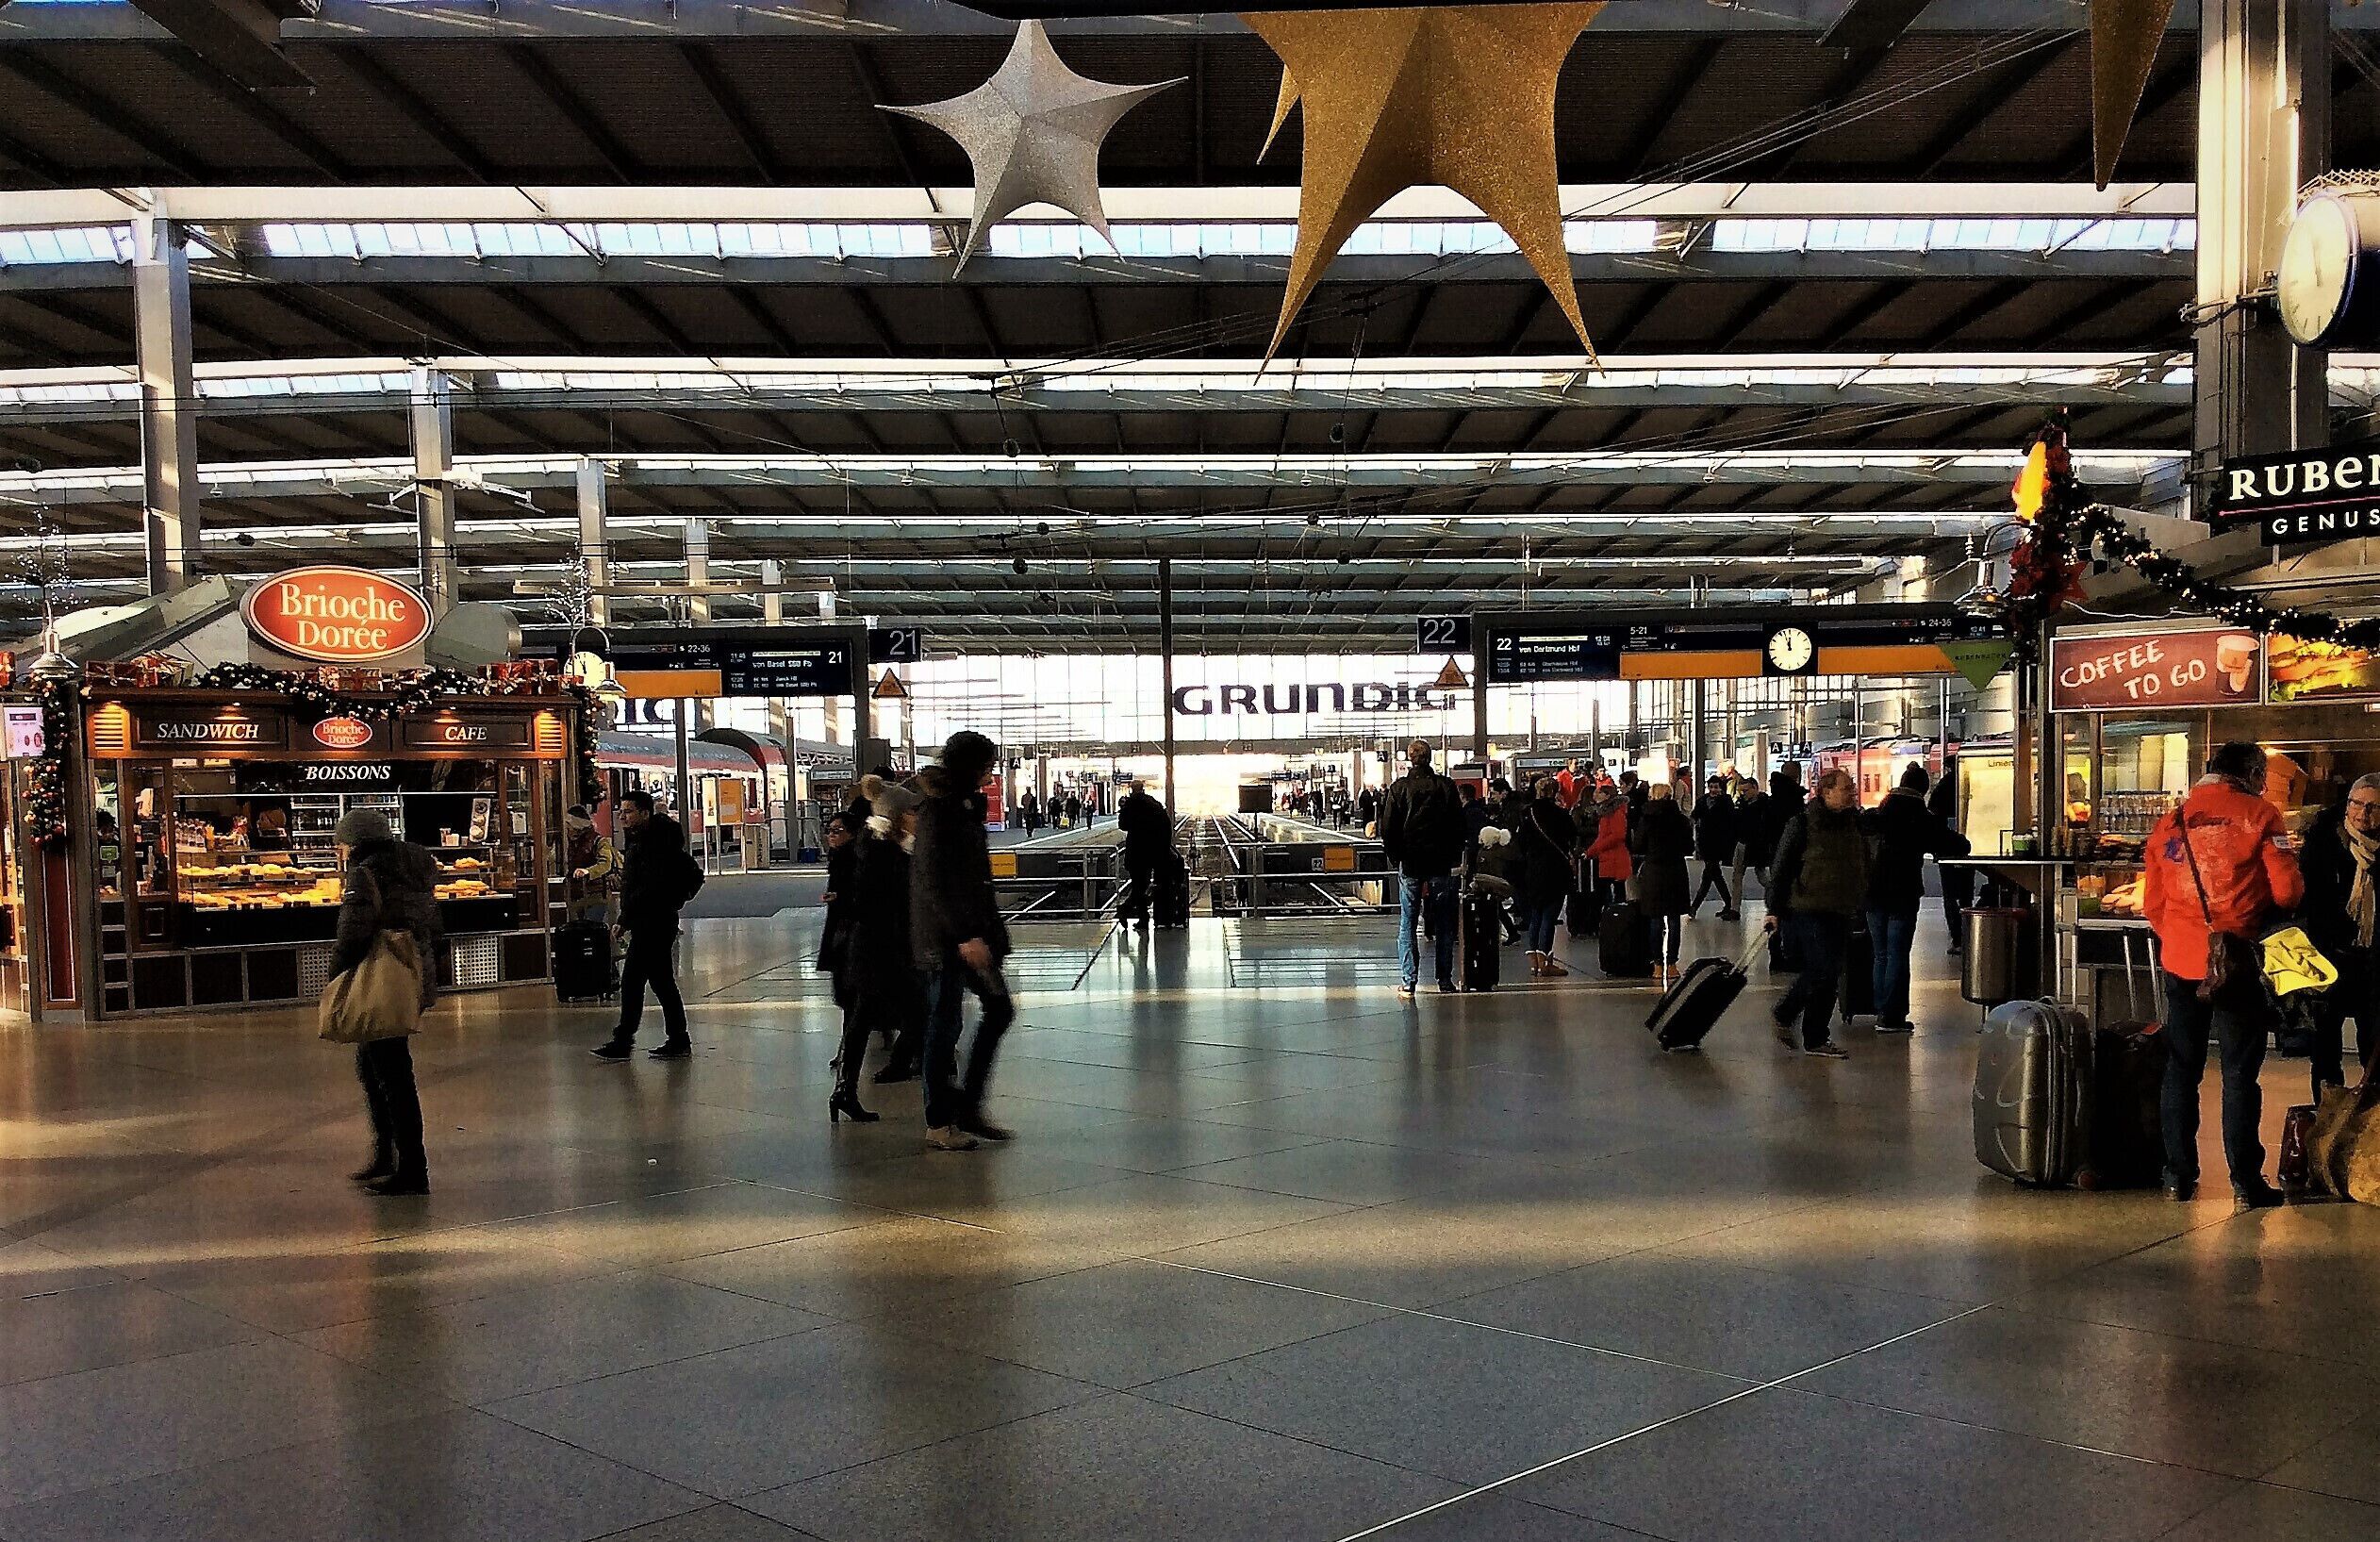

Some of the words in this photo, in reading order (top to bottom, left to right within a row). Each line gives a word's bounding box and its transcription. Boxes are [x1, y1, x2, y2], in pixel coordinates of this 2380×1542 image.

[279, 582, 406, 622] Brioche
[297, 619, 388, 650] Dorée
[1423, 619, 1456, 643] 22
[1629, 626, 1647, 635] 5-21
[687, 644, 711, 653] 22-36
[889, 630, 917, 655] 21
[1496, 638, 1512, 651] 22
[828, 651, 842, 664] 21
[2059, 638, 2165, 688] COFFEE
[2124, 672, 2161, 700] TO
[2170, 659, 2206, 688] GO
[1173, 683, 1456, 715] GRUNDIG
[157, 722, 259, 739] SANDWICH
[322, 721, 366, 737] Brioche
[444, 726, 488, 741] CAFE
[1772, 743, 1779, 752] A
[1803, 742, 1810, 751] A
[1013, 757, 1020, 768] A
[1379, 752, 1386, 760] A
[306, 765, 391, 781] BOISSONS
